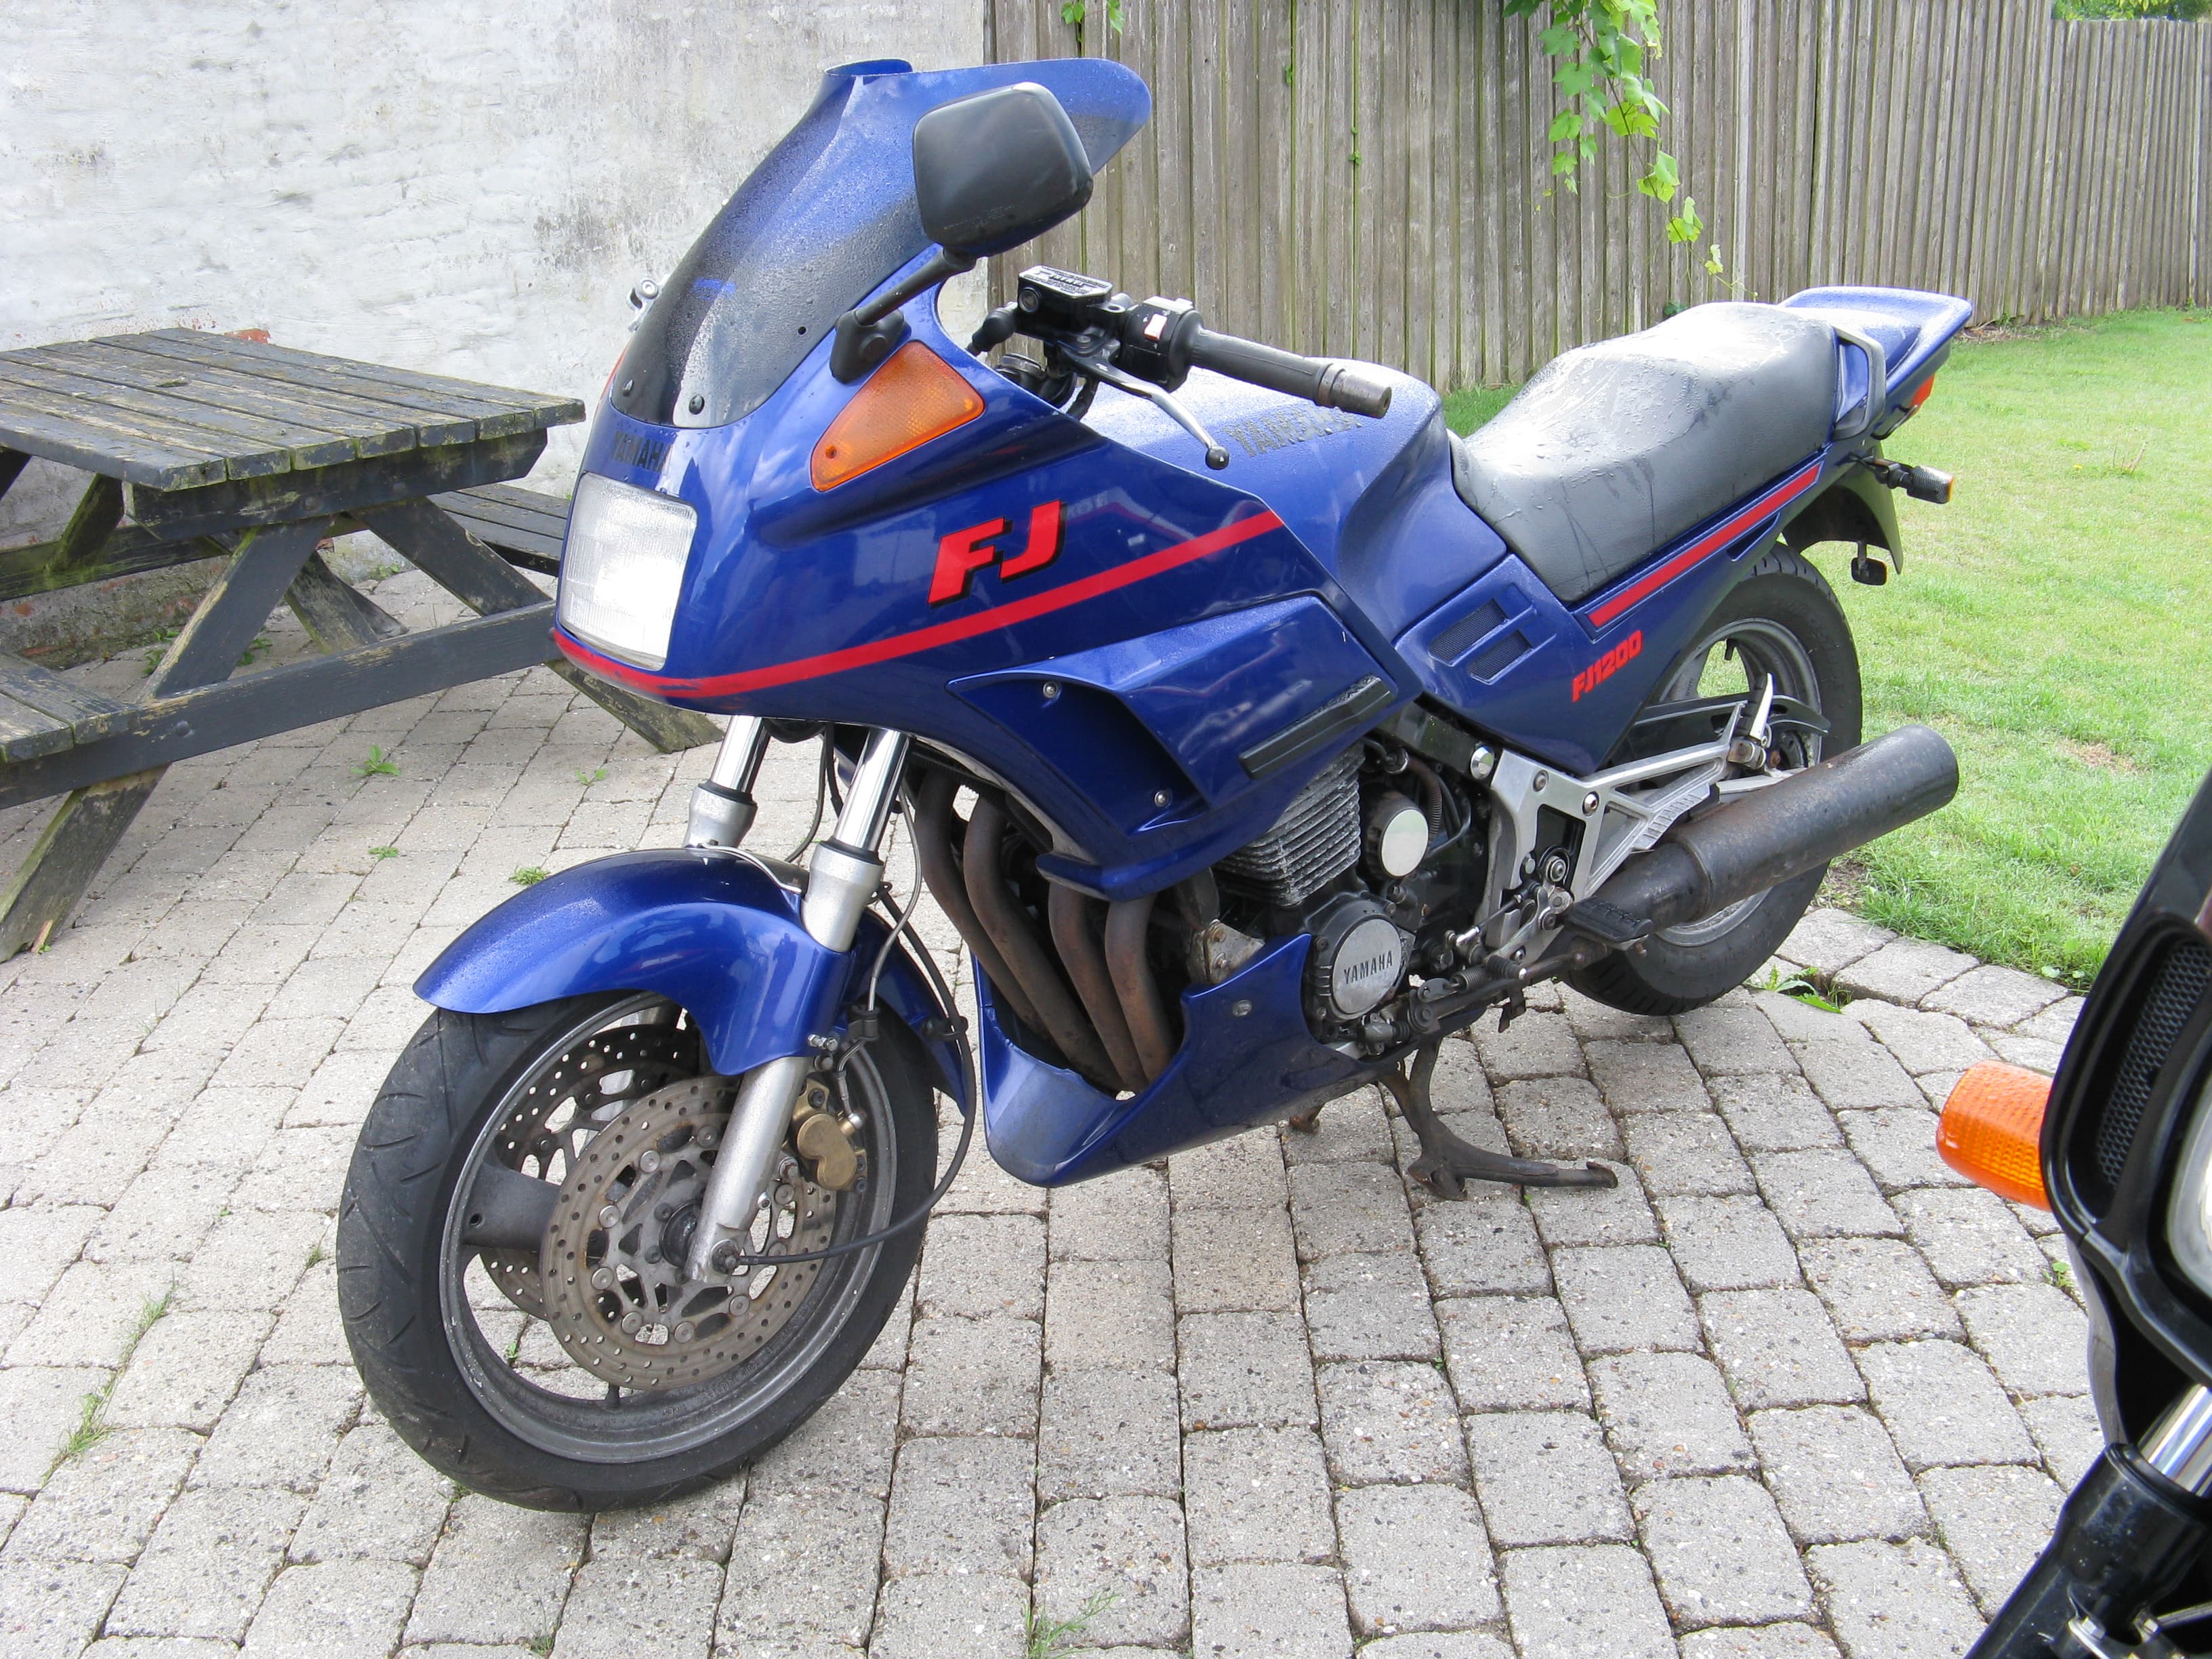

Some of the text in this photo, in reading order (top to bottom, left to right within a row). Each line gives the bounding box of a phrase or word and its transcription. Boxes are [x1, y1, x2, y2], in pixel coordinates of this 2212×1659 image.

[613, 430, 673, 474] YAMAHA
[927, 499, 1067, 609] FJ
[1572, 630, 1643, 703] FJ1200
[1344, 950, 1393, 985] YAMAHA
